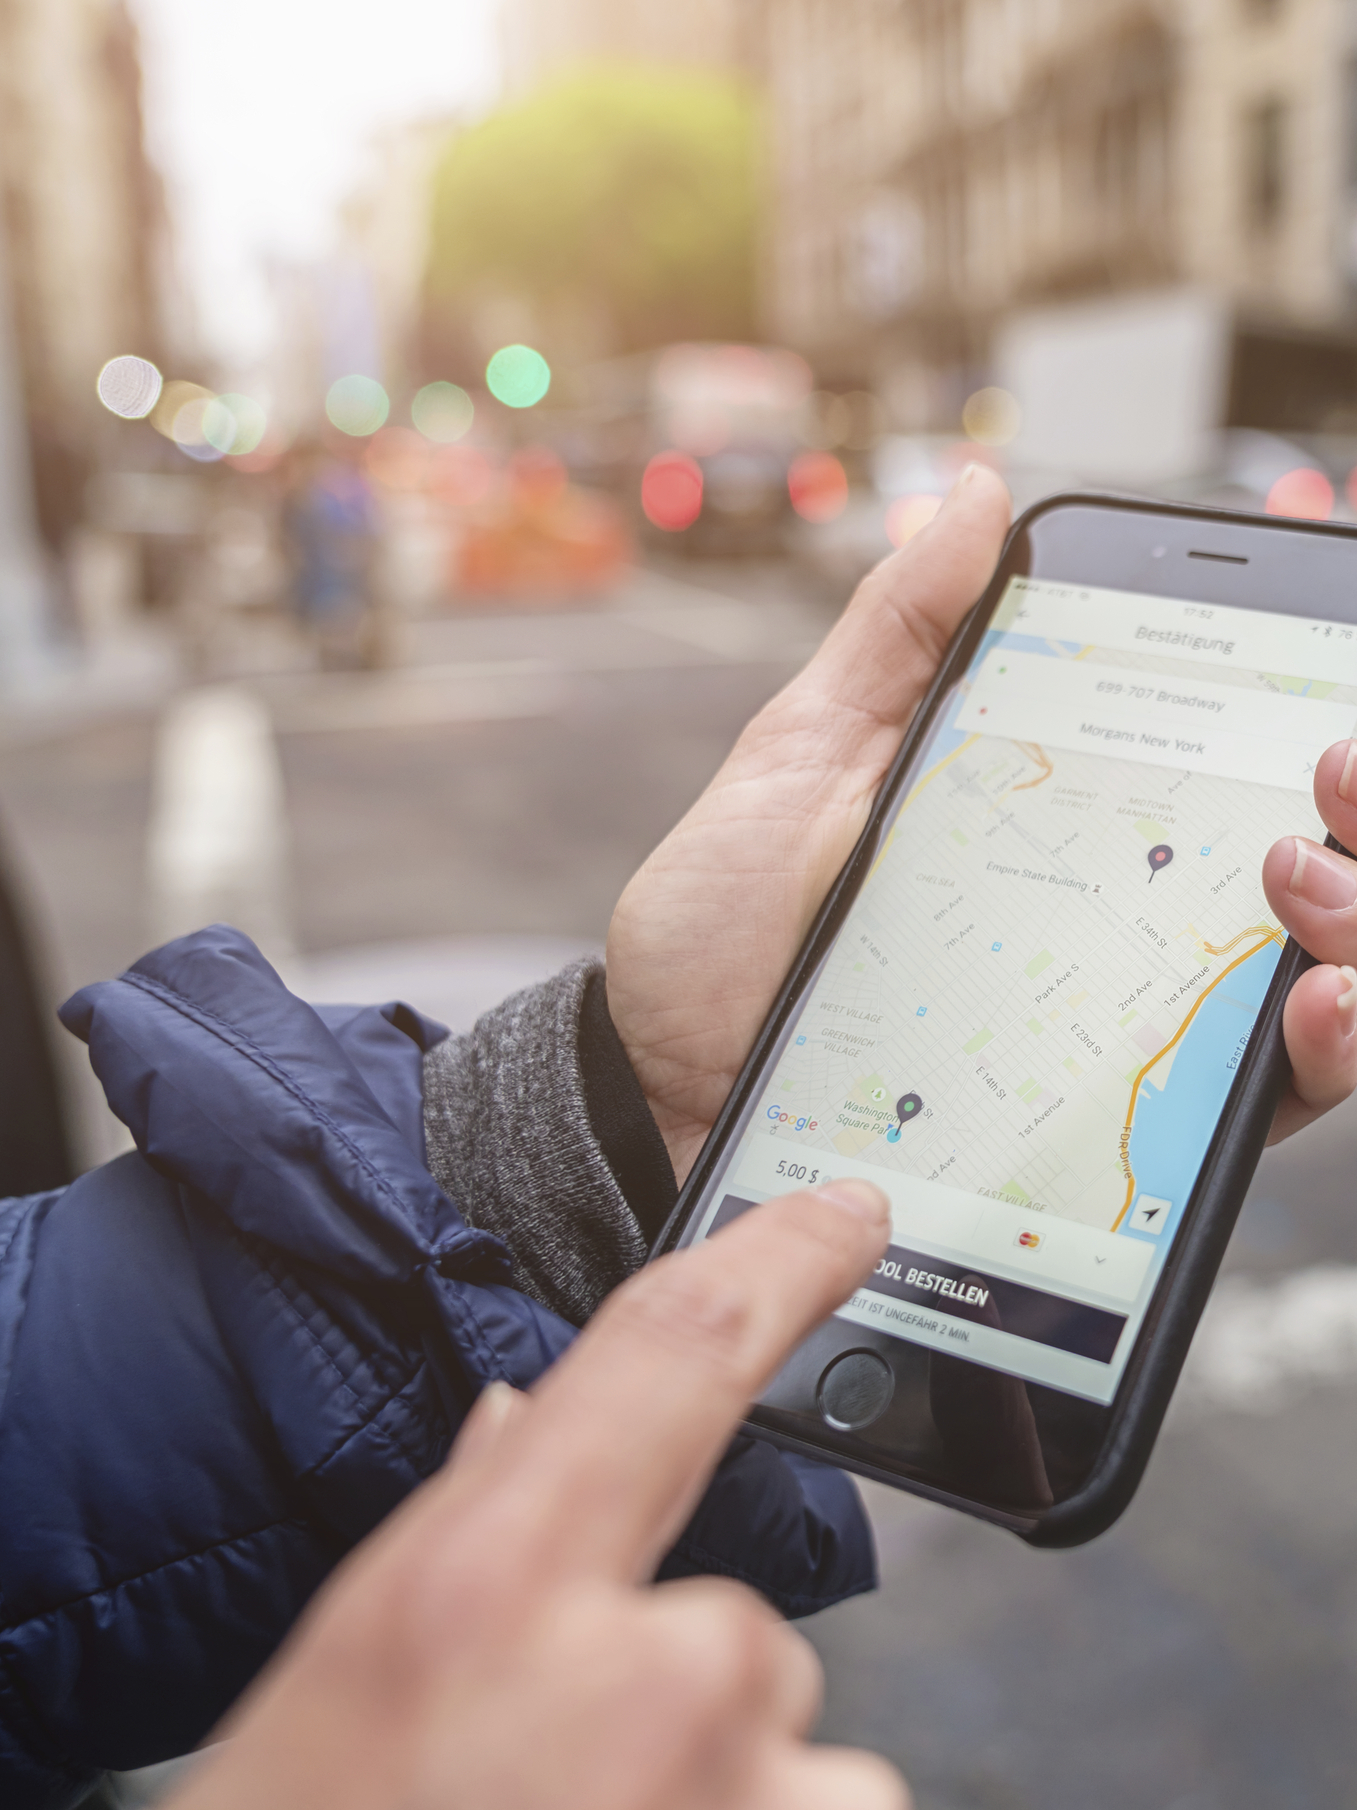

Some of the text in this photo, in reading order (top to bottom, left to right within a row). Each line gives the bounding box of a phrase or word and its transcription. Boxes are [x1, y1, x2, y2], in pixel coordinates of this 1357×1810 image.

[1184, 607, 1214, 620] 17:52
[1134, 626, 1235, 655] Bestätigung
[1338, 629, 1353, 640] 76
[1096, 681, 1226, 713] 699-707 Broadway
[1080, 722, 1206, 755] Morgans New York
[1011, 766, 1026, 779] Ave
[1053, 785, 1099, 800] GARMENT
[1167, 780, 1183, 795] Ave
[1050, 797, 1092, 812] DISTRICT
[1116, 806, 1177, 825] MANHATTAN
[1128, 797, 1175, 812] MIDTOWN
[985, 812, 1015, 837] 9th Ave
[1050, 831, 1080, 858] 7th Ave
[915, 873, 956, 888] CHELSEA
[986, 861, 1088, 892] Empire State Building
[1210, 866, 1243, 895] 3rd Ave
[934, 894, 965, 922] 8th Ave
[944, 923, 975, 951] 7th Ave
[1135, 917, 1168, 949] E 34th St
[860, 934, 889, 968] W 14th St
[1035, 963, 1080, 1004] Park Ave S
[1118, 979, 1153, 1012] 2nd Ave
[1164, 965, 1211, 1008] 1st Avenue
[819, 1001, 884, 1024] WEST VILLAGE
[820, 1027, 876, 1048] GREENWICH
[823, 1041, 862, 1058] VILLAGE
[1070, 1023, 1103, 1057] E 23rd St
[1226, 1046, 1244, 1069] East
[975, 1066, 1007, 1100] E 14th St
[767, 1104, 818, 1131] Google
[836, 1113, 889, 1135] Square Par
[843, 1100, 899, 1124] Washington
[923, 1108, 934, 1120] St
[1018, 1096, 1066, 1139] 1st Avenue
[1118, 1126, 1133, 1179] FDR Drive
[775, 1160, 820, 1184] 5,00 $
[926, 1156, 956, 1181] nd Ave
[1005, 1194, 1048, 1213] VILLAGE
[873, 1258, 989, 1308] OOL BESTELLEN
[848, 1296, 971, 1342] EIT IST UNGEFÄHR 2 MIN.
